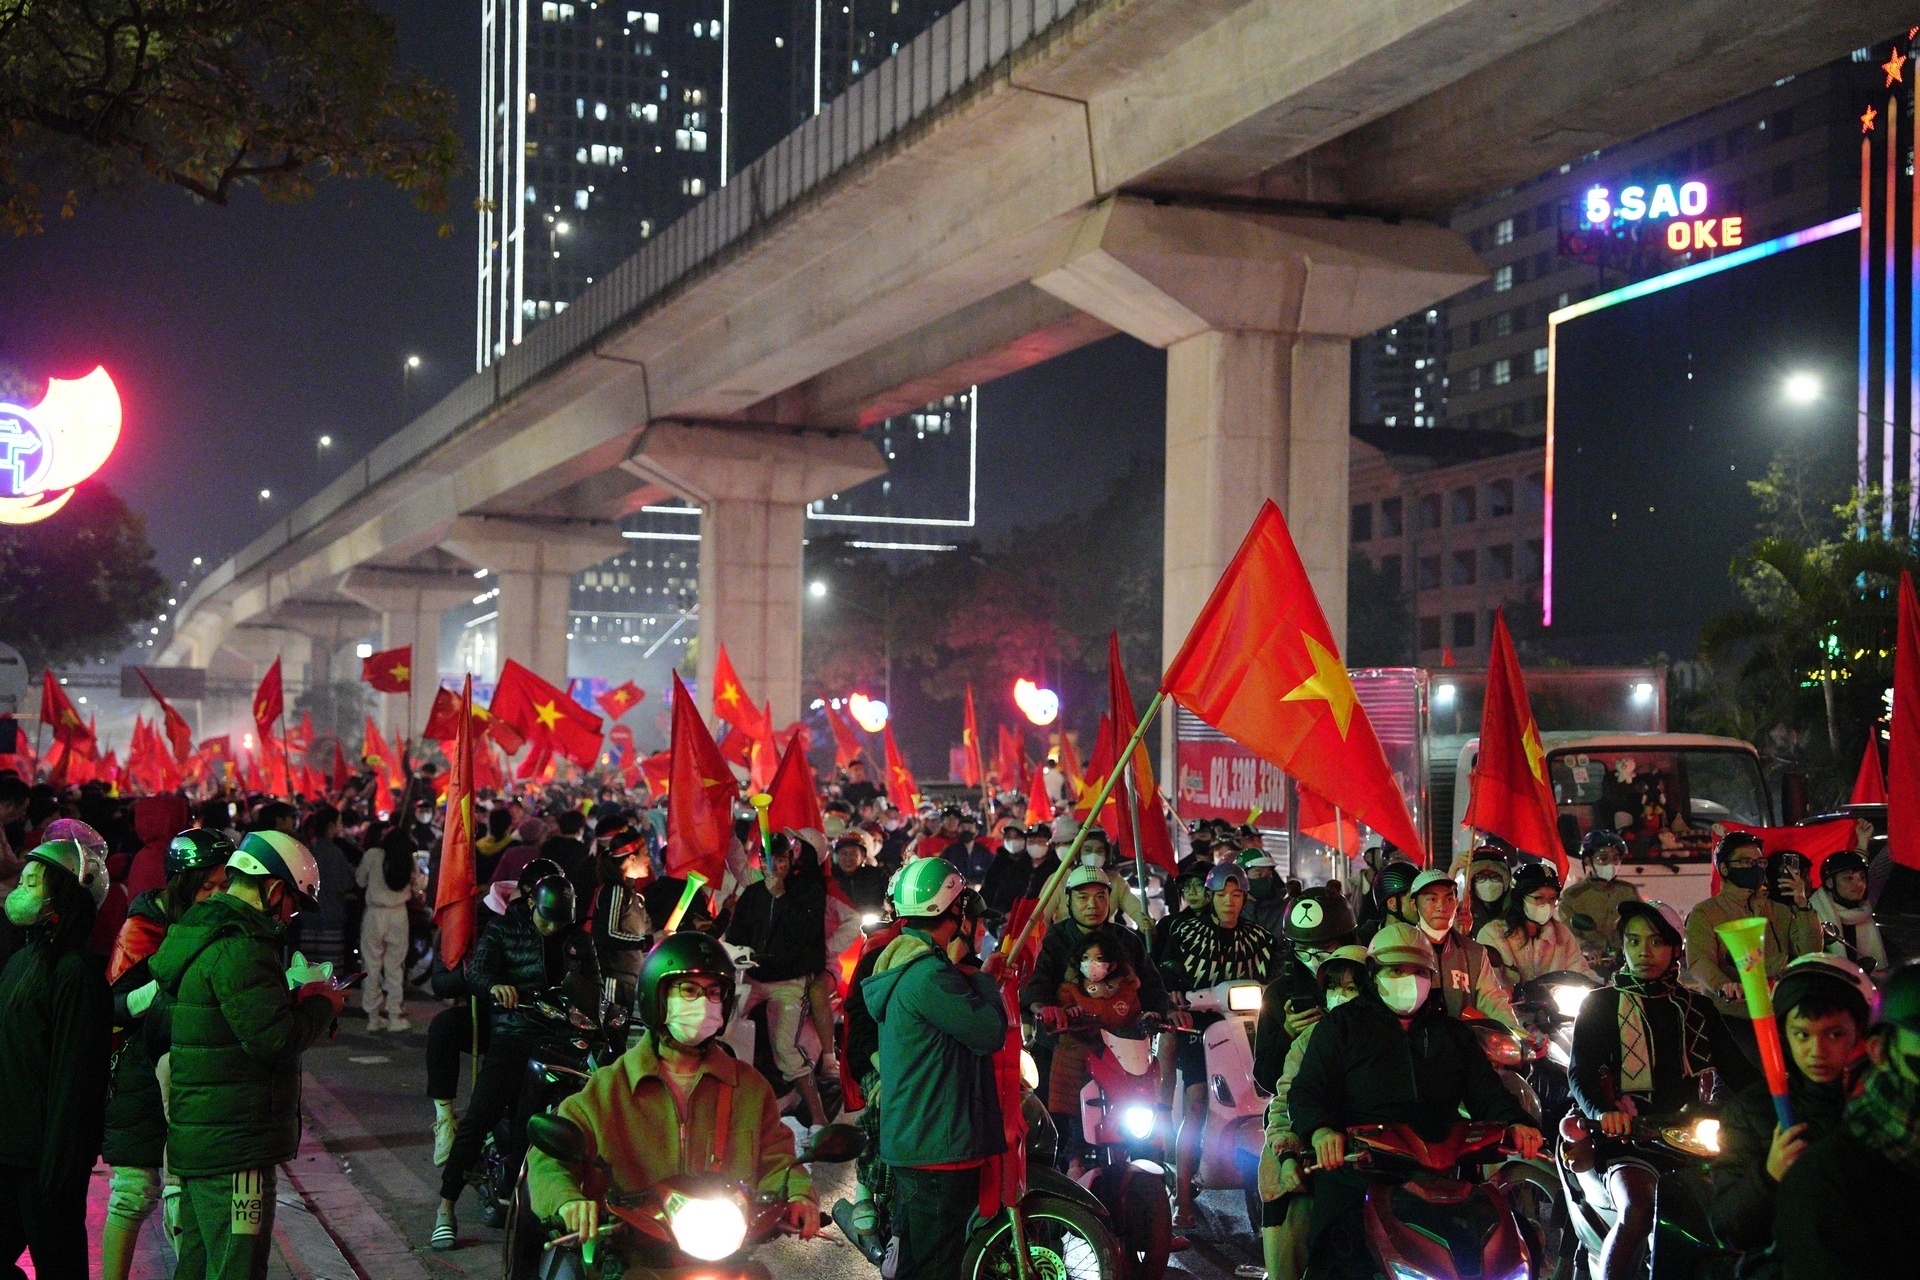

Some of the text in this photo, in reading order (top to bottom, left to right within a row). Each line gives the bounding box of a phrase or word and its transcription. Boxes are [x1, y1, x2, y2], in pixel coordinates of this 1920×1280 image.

[1586, 181, 1708, 223] 5 SAO
[1667, 217, 1743, 250] OKE
[1451, 970, 1470, 993] FR
